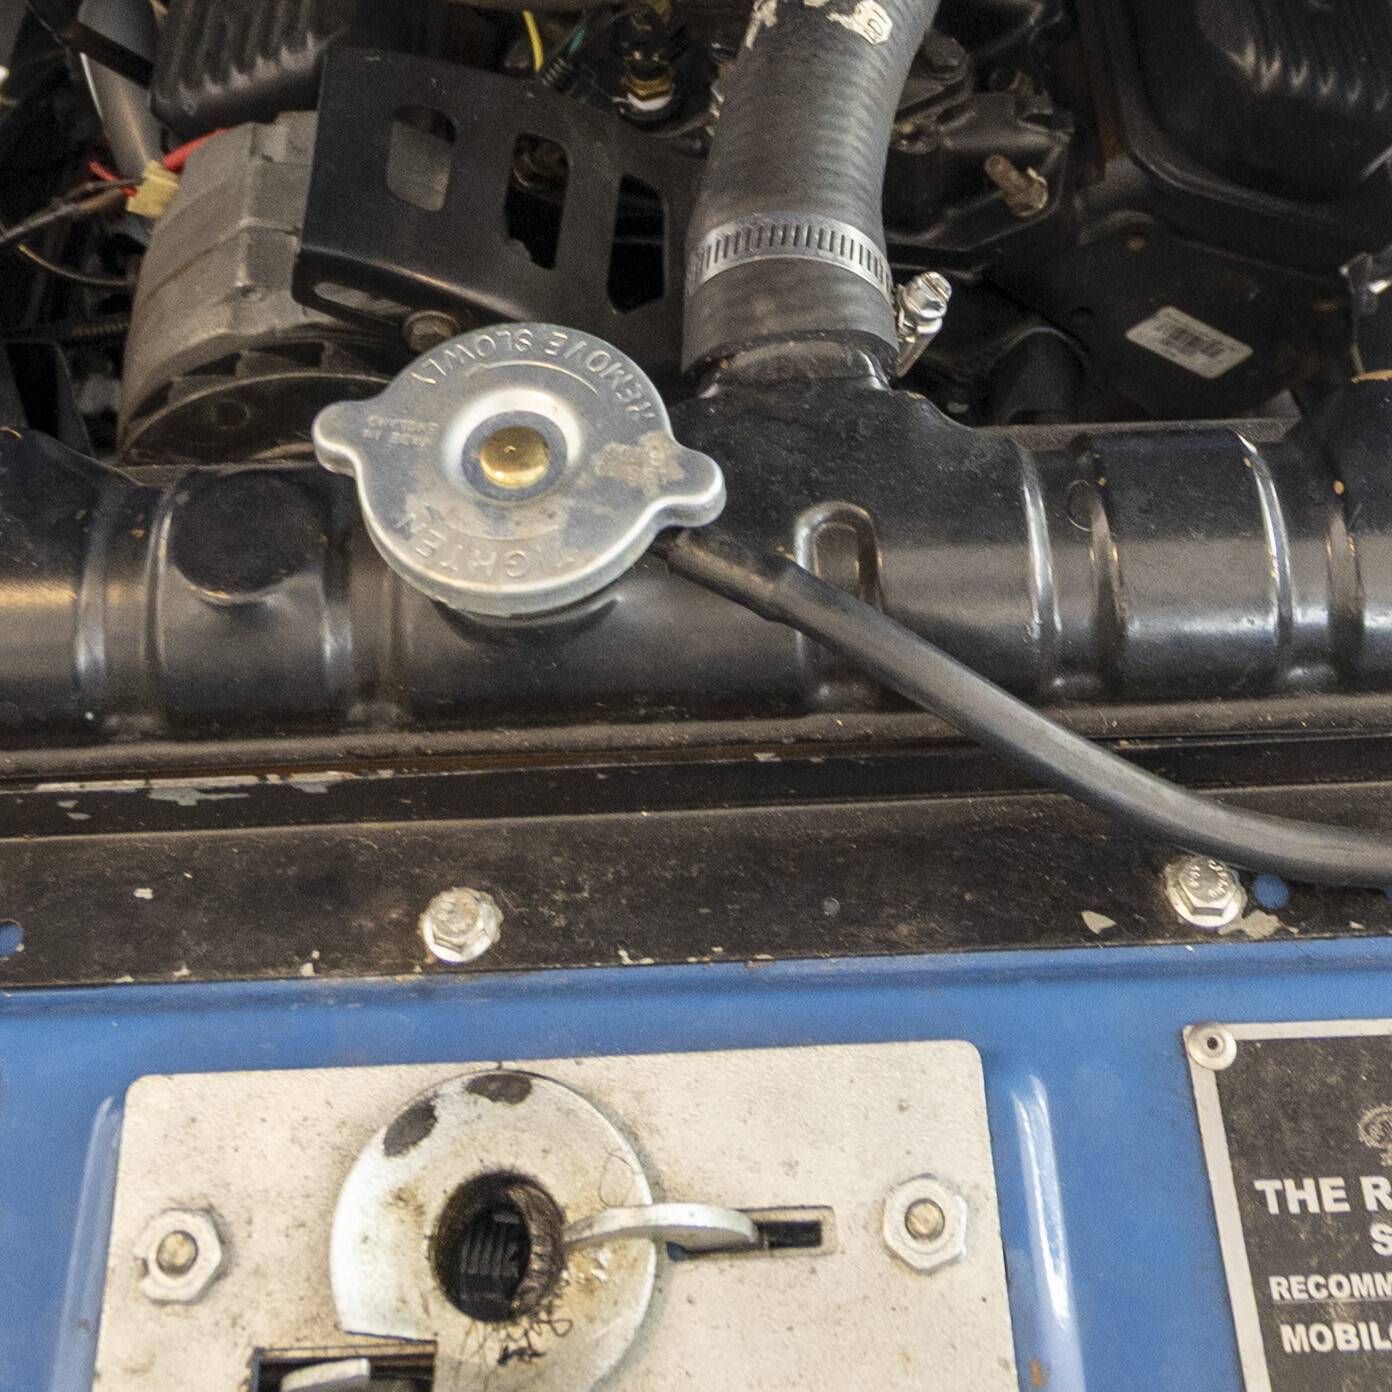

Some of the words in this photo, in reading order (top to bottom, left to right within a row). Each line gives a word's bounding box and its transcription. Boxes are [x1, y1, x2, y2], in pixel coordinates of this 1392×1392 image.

[411, 328, 533, 386] SLOWLY
[544, 330, 655, 421] REMOVE
[1253, 1176, 1351, 1215] THE
